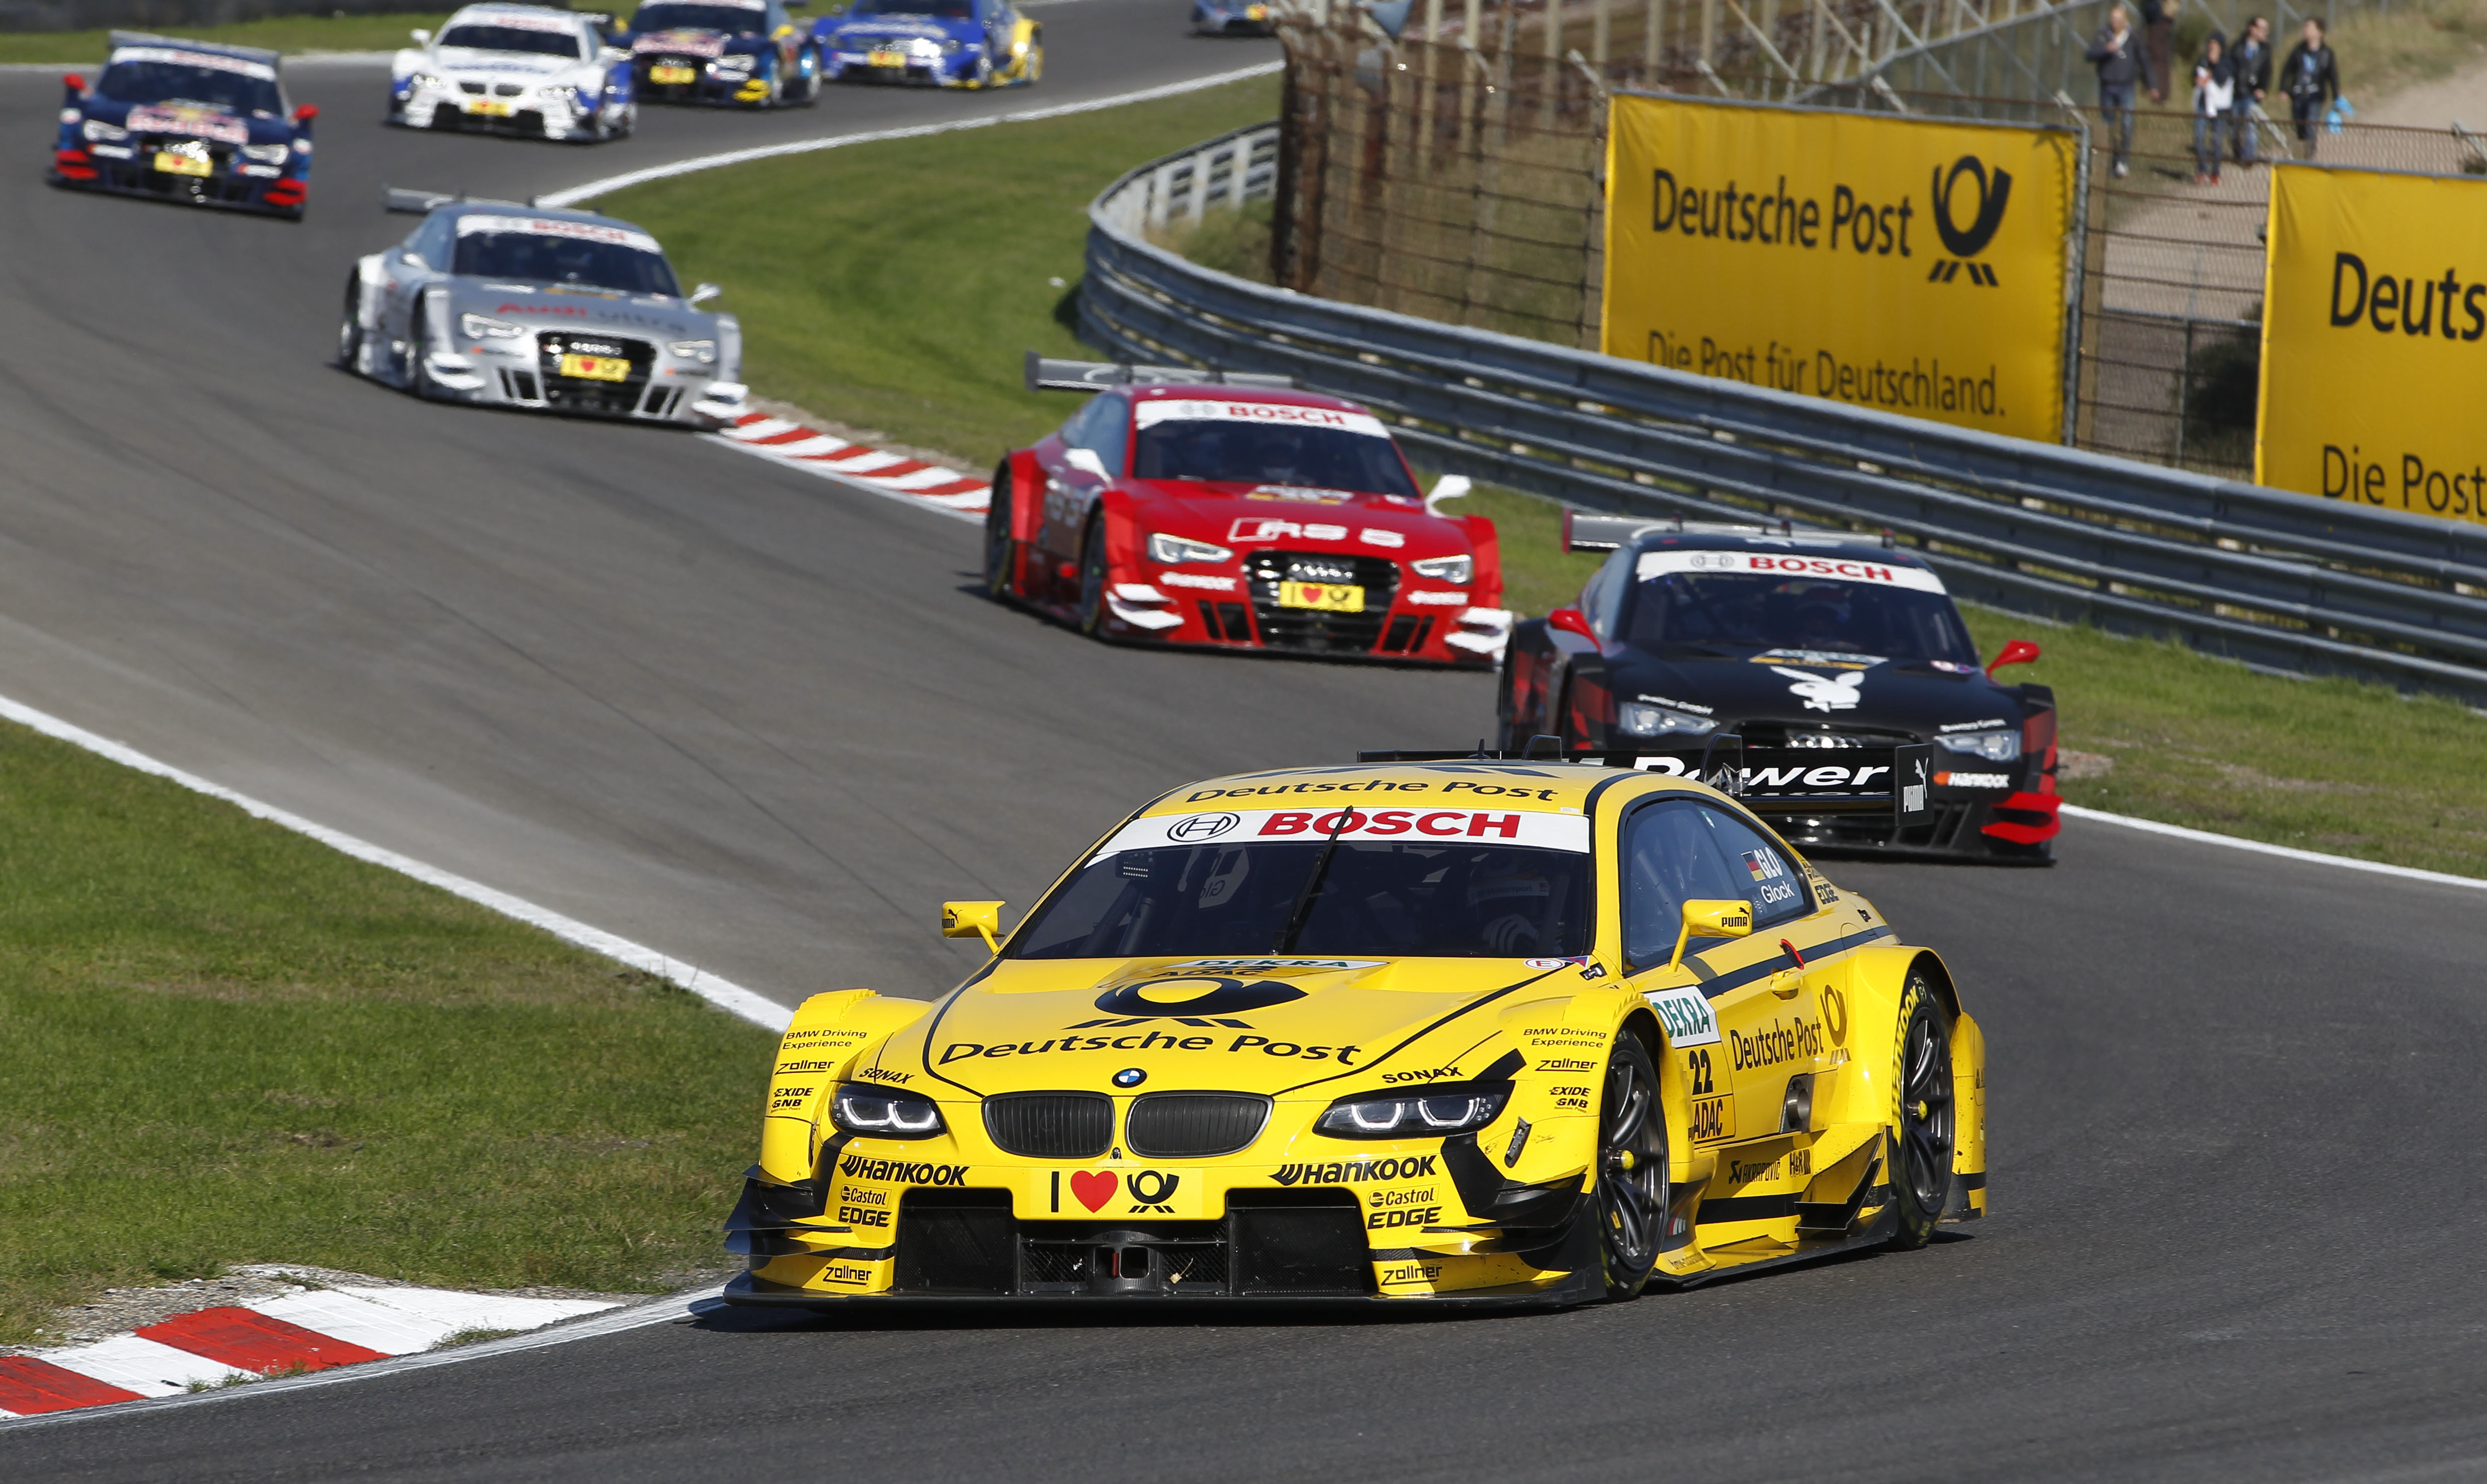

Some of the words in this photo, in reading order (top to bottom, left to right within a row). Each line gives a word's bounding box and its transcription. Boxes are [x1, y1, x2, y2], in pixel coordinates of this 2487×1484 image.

[1653, 169, 1819, 250] Deutsche
[1830, 184, 1913, 257] Post
[2330, 252, 2487, 341] Deuts
[1648, 330, 1692, 365] Die
[1700, 336, 1757, 383] Post
[1765, 340, 1807, 395] für
[1818, 350, 2005, 416] Deutschland.
[1228, 403, 1346, 426] BOSCH
[2323, 444, 2386, 505] Die
[2402, 453, 2487, 519] Post
[1749, 556, 1893, 581] BOSCH
[1633, 756, 1890, 786] Pwer
[1185, 779, 1409, 803] Deutsche
[1441, 781, 1560, 801] Post
[1903, 784, 1924, 813] PUMA
[1257, 811, 1521, 839] BOSCH
[1754, 846, 1783, 879] GLO
[1761, 880, 1795, 904] Glock
[1721, 917, 1748, 927] PUMA
[1652, 995, 1711, 1038] DEKRA
[782, 1039, 852, 1050] Experience
[786, 1030, 820, 1040] BMW
[822, 1029, 867, 1039] Driving
[1531, 1038, 1604, 1048] Experience
[1561, 1028, 1607, 1039] Driving
[1730, 1018, 1795, 1072] Deutsche
[1795, 1015, 1824, 1059] Post
[937, 1031, 1215, 1066] Deutsche
[1228, 1035, 1362, 1066] Post
[858, 1068, 916, 1084] SONAX
[1381, 1066, 1465, 1084] SONAX
[1688, 1048, 1713, 1096] 22
[772, 1099, 802, 1108] GNB
[774, 1088, 814, 1097] EXIDE
[1549, 1087, 1591, 1097] EXIDE
[1555, 1098, 1588, 1108] GNB
[1688, 1099, 1724, 1142] ADAC
[850, 1188, 888, 1205] Castrol
[1051, 1171, 1060, 1213] I
[1385, 1187, 1435, 1206] Castrol
[838, 1206, 892, 1227] EDGE
[1367, 1206, 1443, 1229] EDGE
